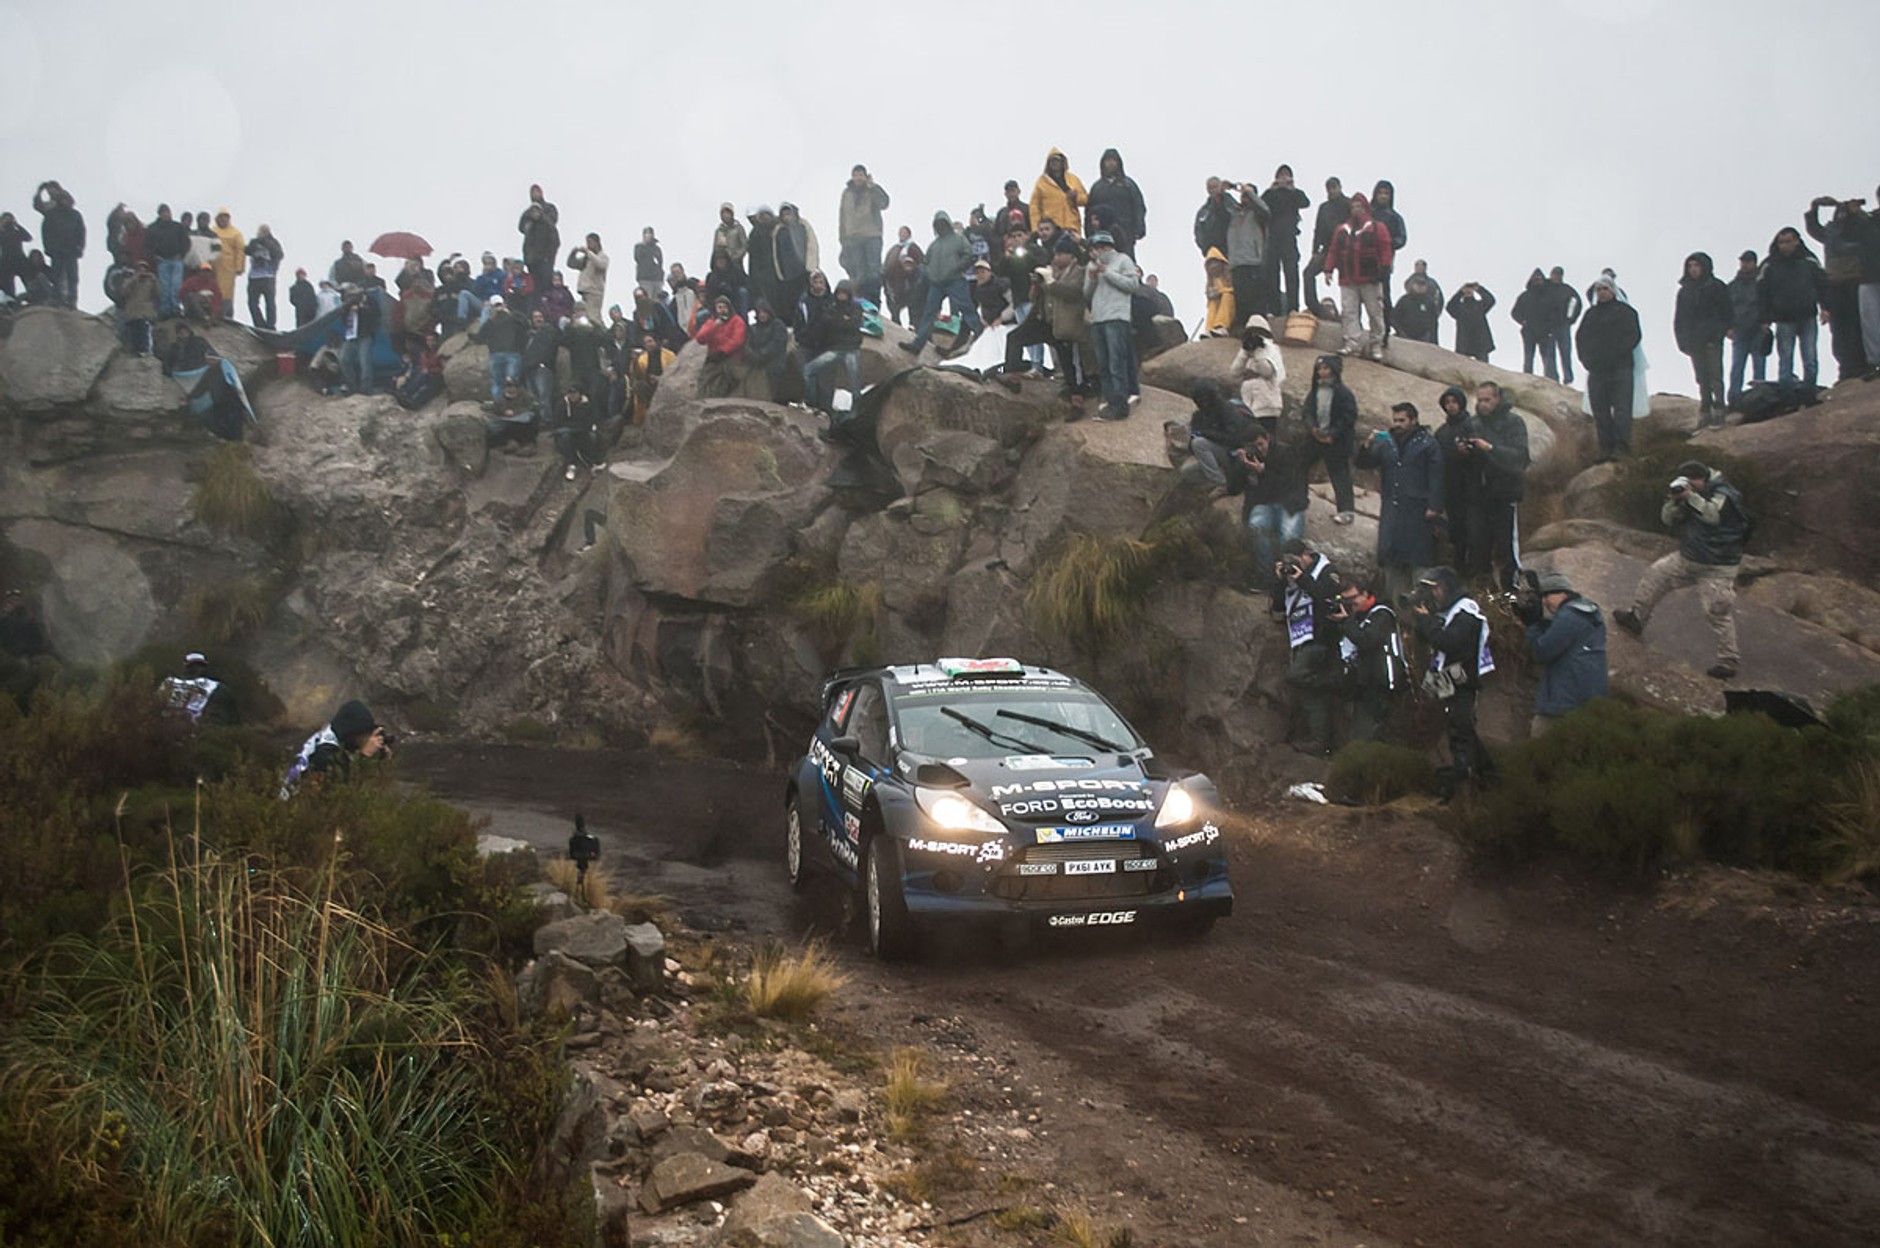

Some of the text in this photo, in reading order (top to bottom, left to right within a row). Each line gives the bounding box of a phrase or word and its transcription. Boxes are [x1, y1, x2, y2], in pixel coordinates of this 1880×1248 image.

[992, 779, 1142, 796] M-SPORT
[1001, 797, 1155, 816] FORD EcoBoost
[1064, 826, 1132, 837] MICHELIN
[909, 838, 979, 856] M-SPORT
[1164, 831, 1205, 852] M-SPORT
[1093, 862, 1112, 871] AYK
[1087, 910, 1137, 925] EDGE
